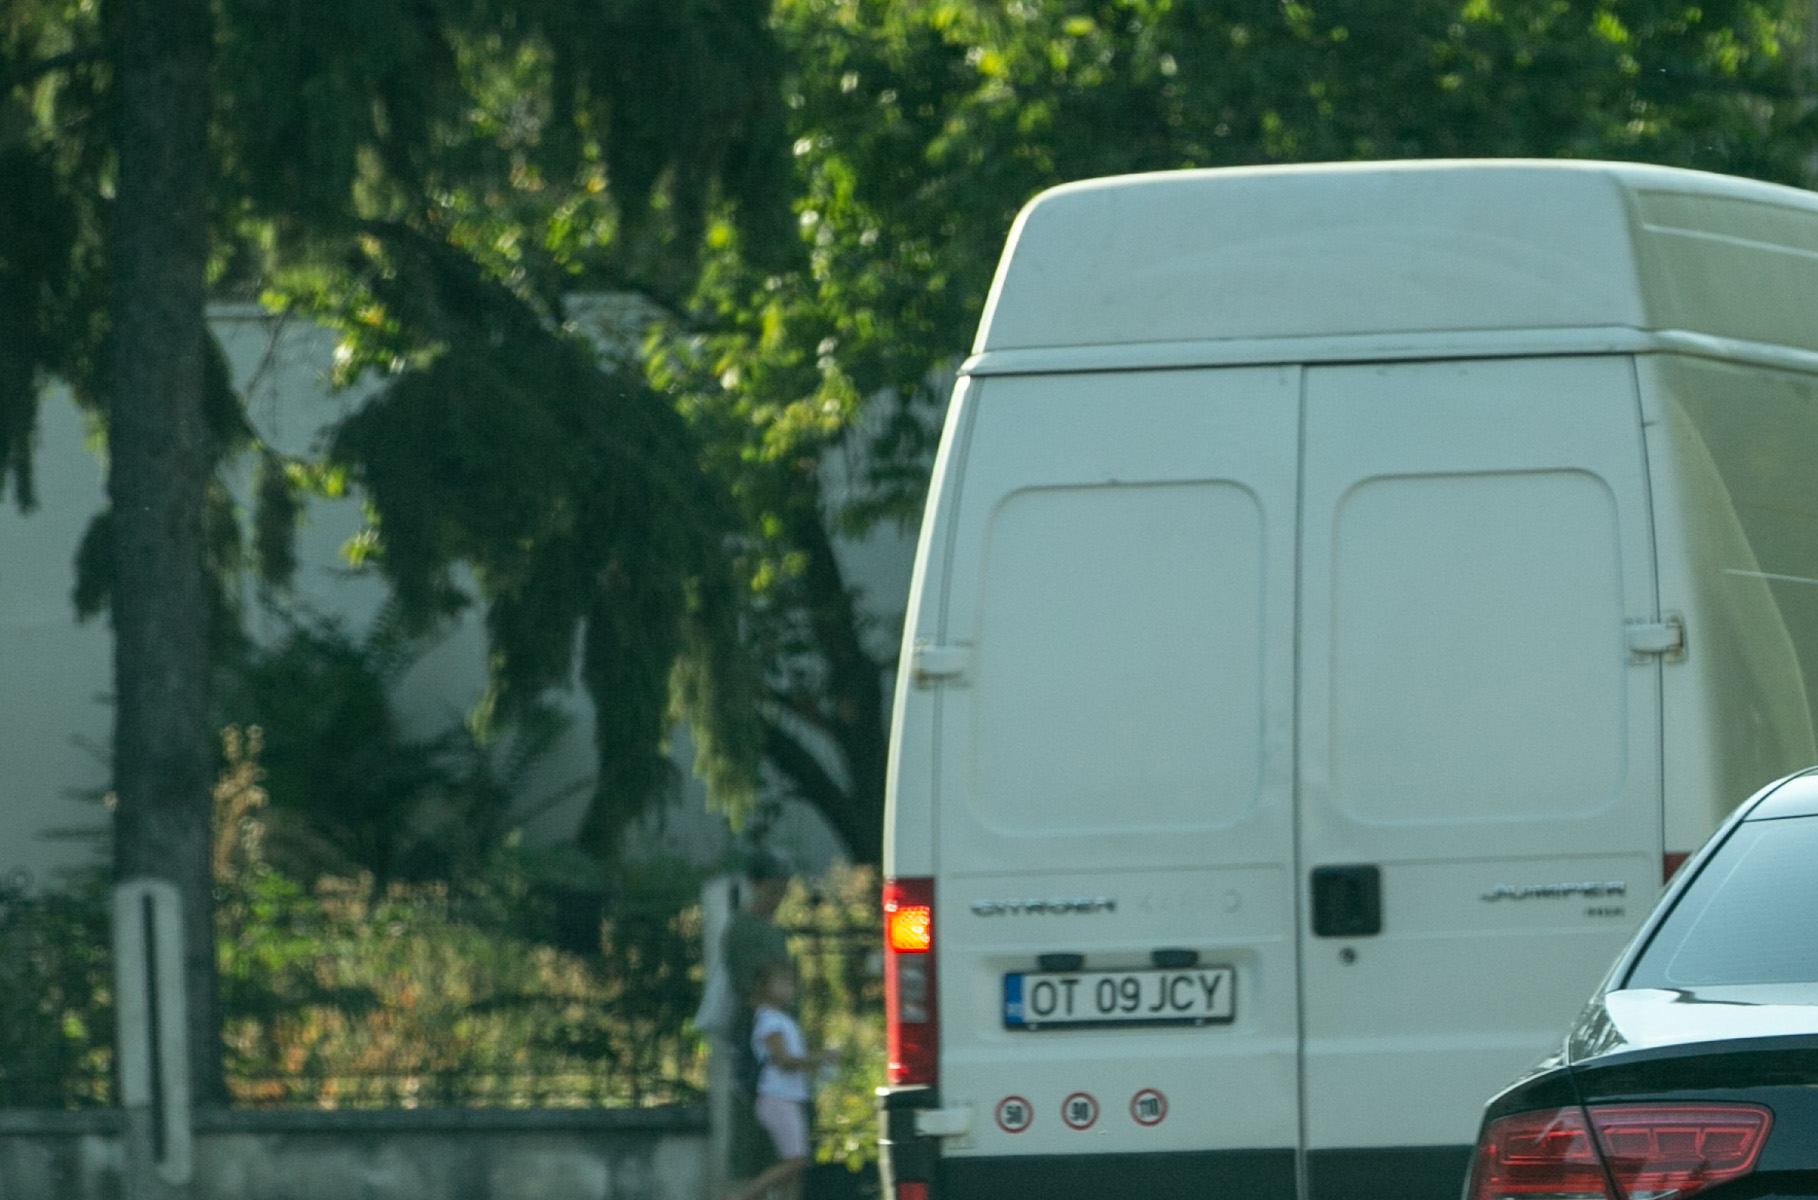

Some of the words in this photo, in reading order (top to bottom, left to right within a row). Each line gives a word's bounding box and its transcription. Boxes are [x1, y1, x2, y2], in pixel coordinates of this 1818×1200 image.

[1030, 979, 1081, 1017] OT
[1096, 976, 1142, 1013] 09
[1148, 973, 1222, 1012] JCY
[1006, 1105, 1023, 1124] 50
[1072, 1102, 1089, 1121] 90
[1137, 1098, 1160, 1118] 110
